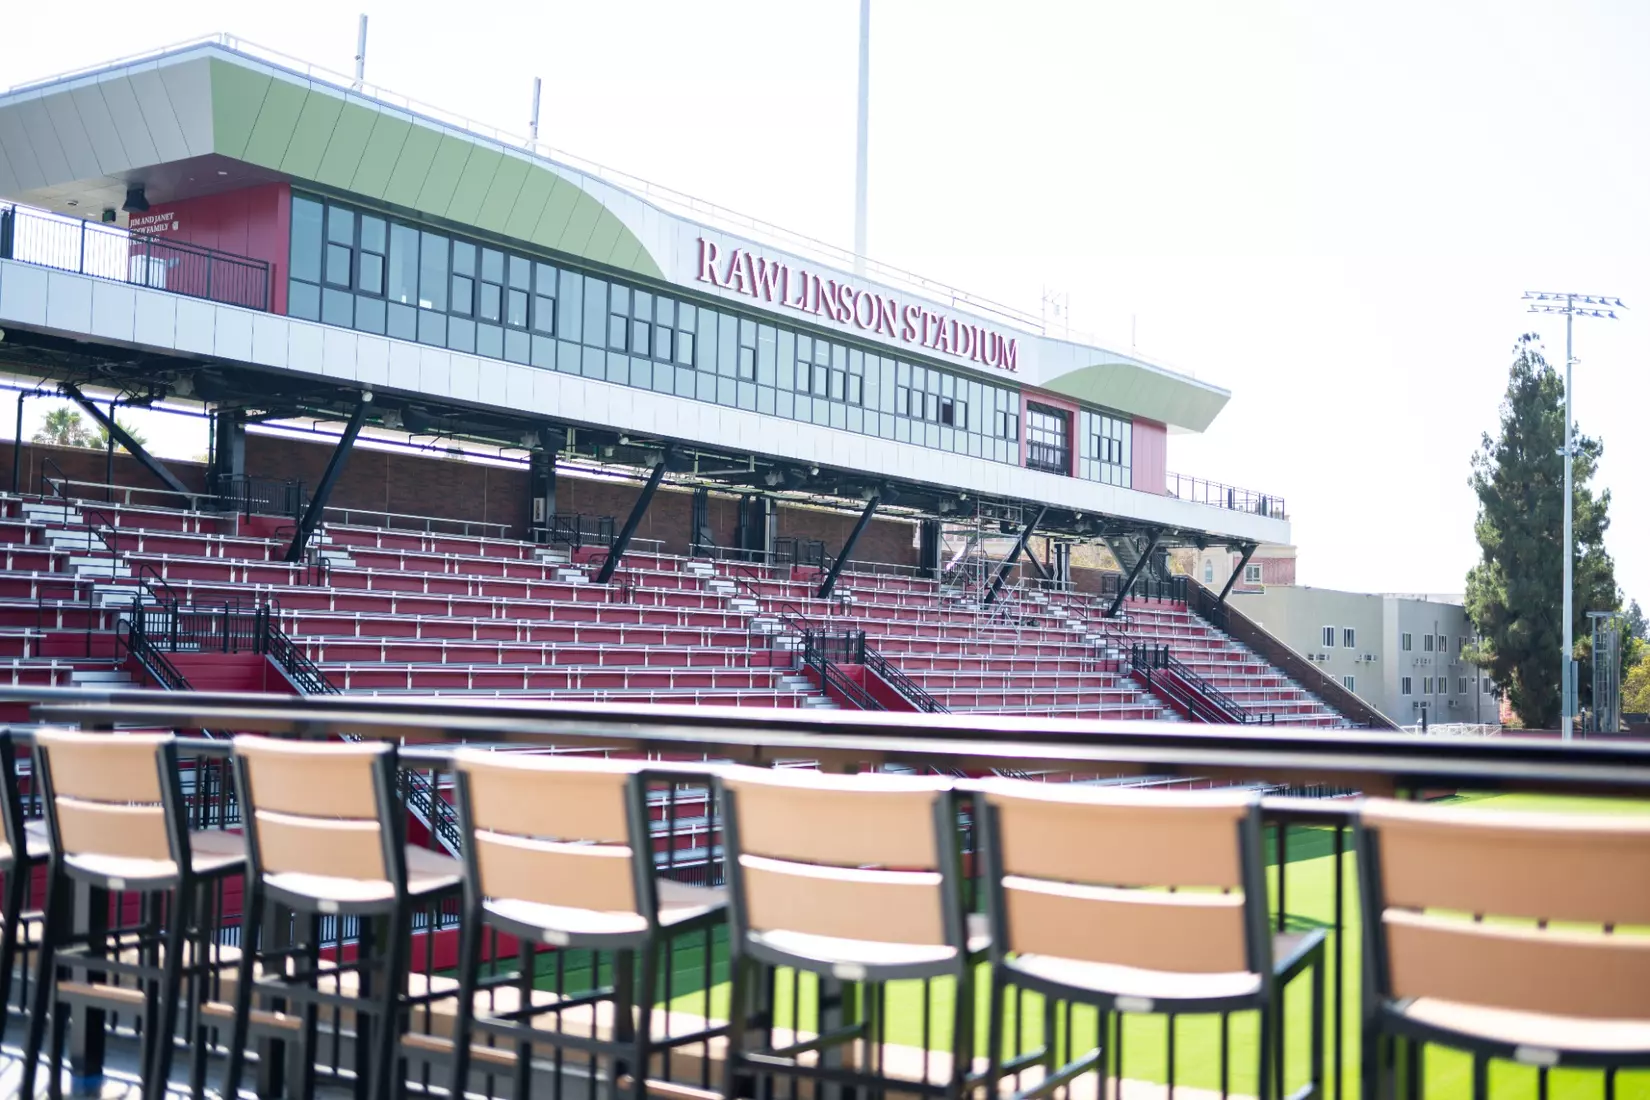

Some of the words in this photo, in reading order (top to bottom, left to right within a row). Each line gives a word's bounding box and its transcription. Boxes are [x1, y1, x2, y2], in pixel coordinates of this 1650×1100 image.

[141, 216, 154, 224] AND
[154, 212, 174, 224] JANET
[147, 223, 168, 233] FAMILY
[697, 237, 899, 338] RAWLINSON
[902, 304, 1021, 373] STADIUM
